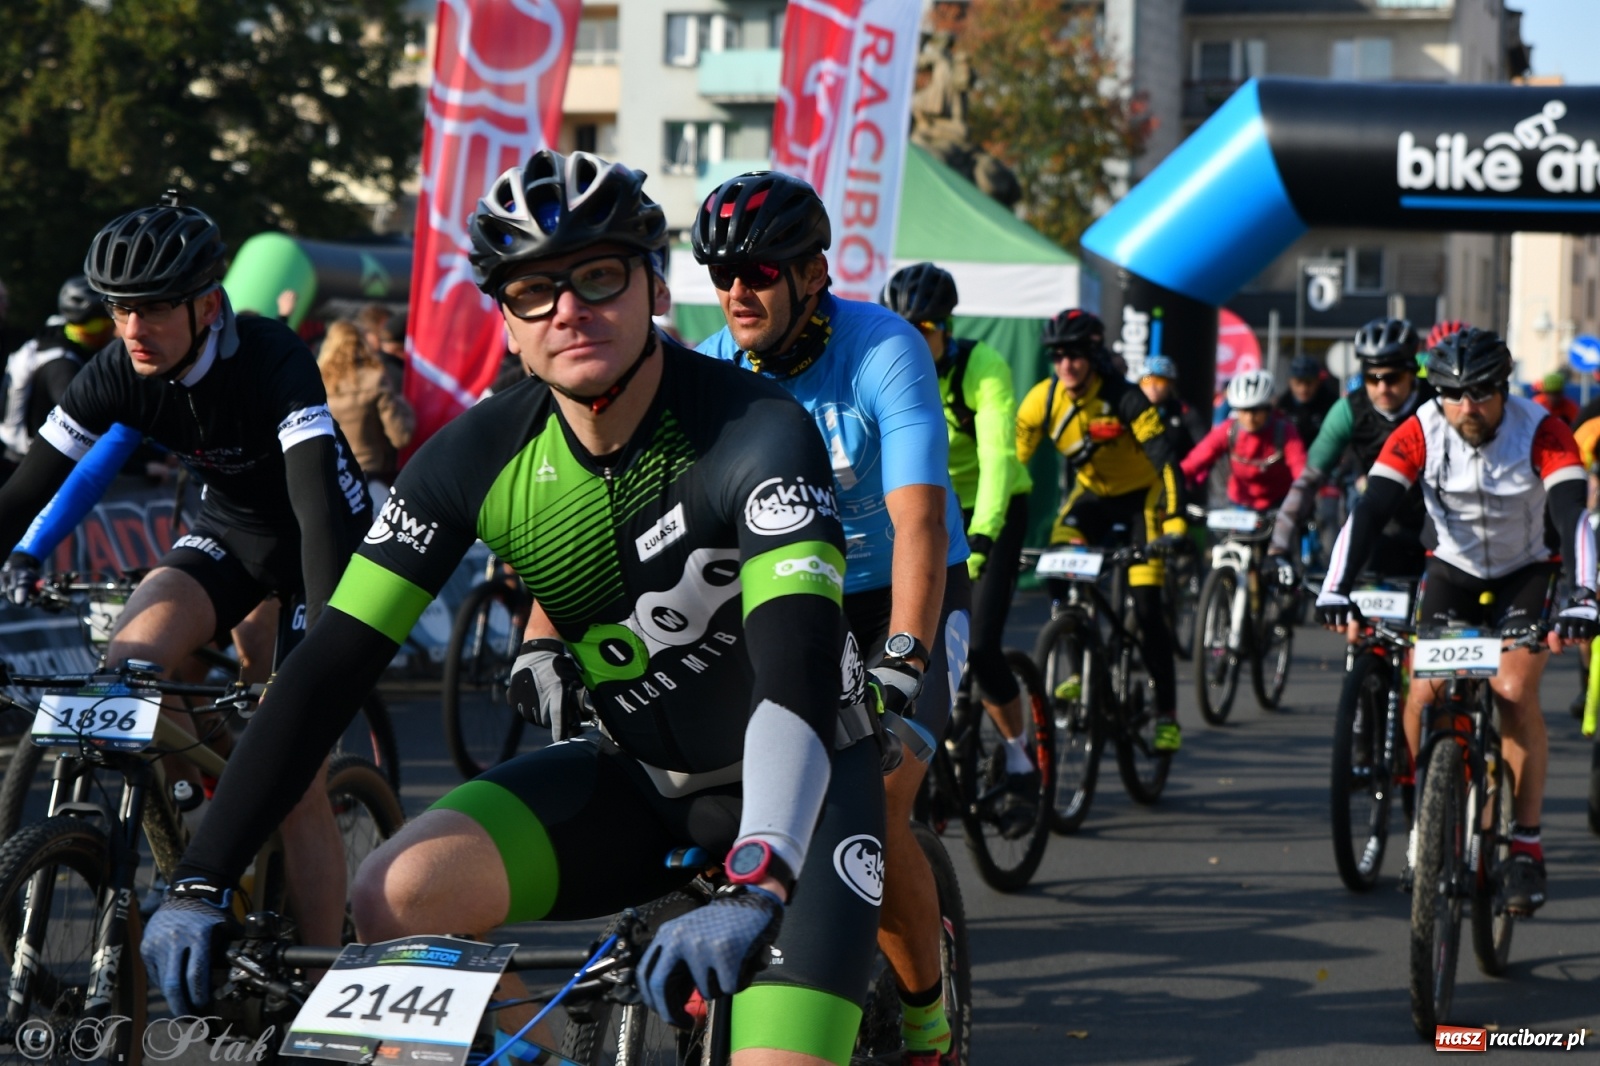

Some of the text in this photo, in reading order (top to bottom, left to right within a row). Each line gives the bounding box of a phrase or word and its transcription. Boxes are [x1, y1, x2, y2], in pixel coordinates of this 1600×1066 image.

[1397, 131, 1600, 194] bike at
[776, 476, 838, 513] kiwi
[380, 496, 439, 546] kiwi
[1353, 596, 1395, 611] 082
[614, 631, 738, 714] KLUB MTB
[1428, 646, 1484, 664] 2025
[57, 707, 137, 732] 1896
[326, 983, 455, 1027] 2144
